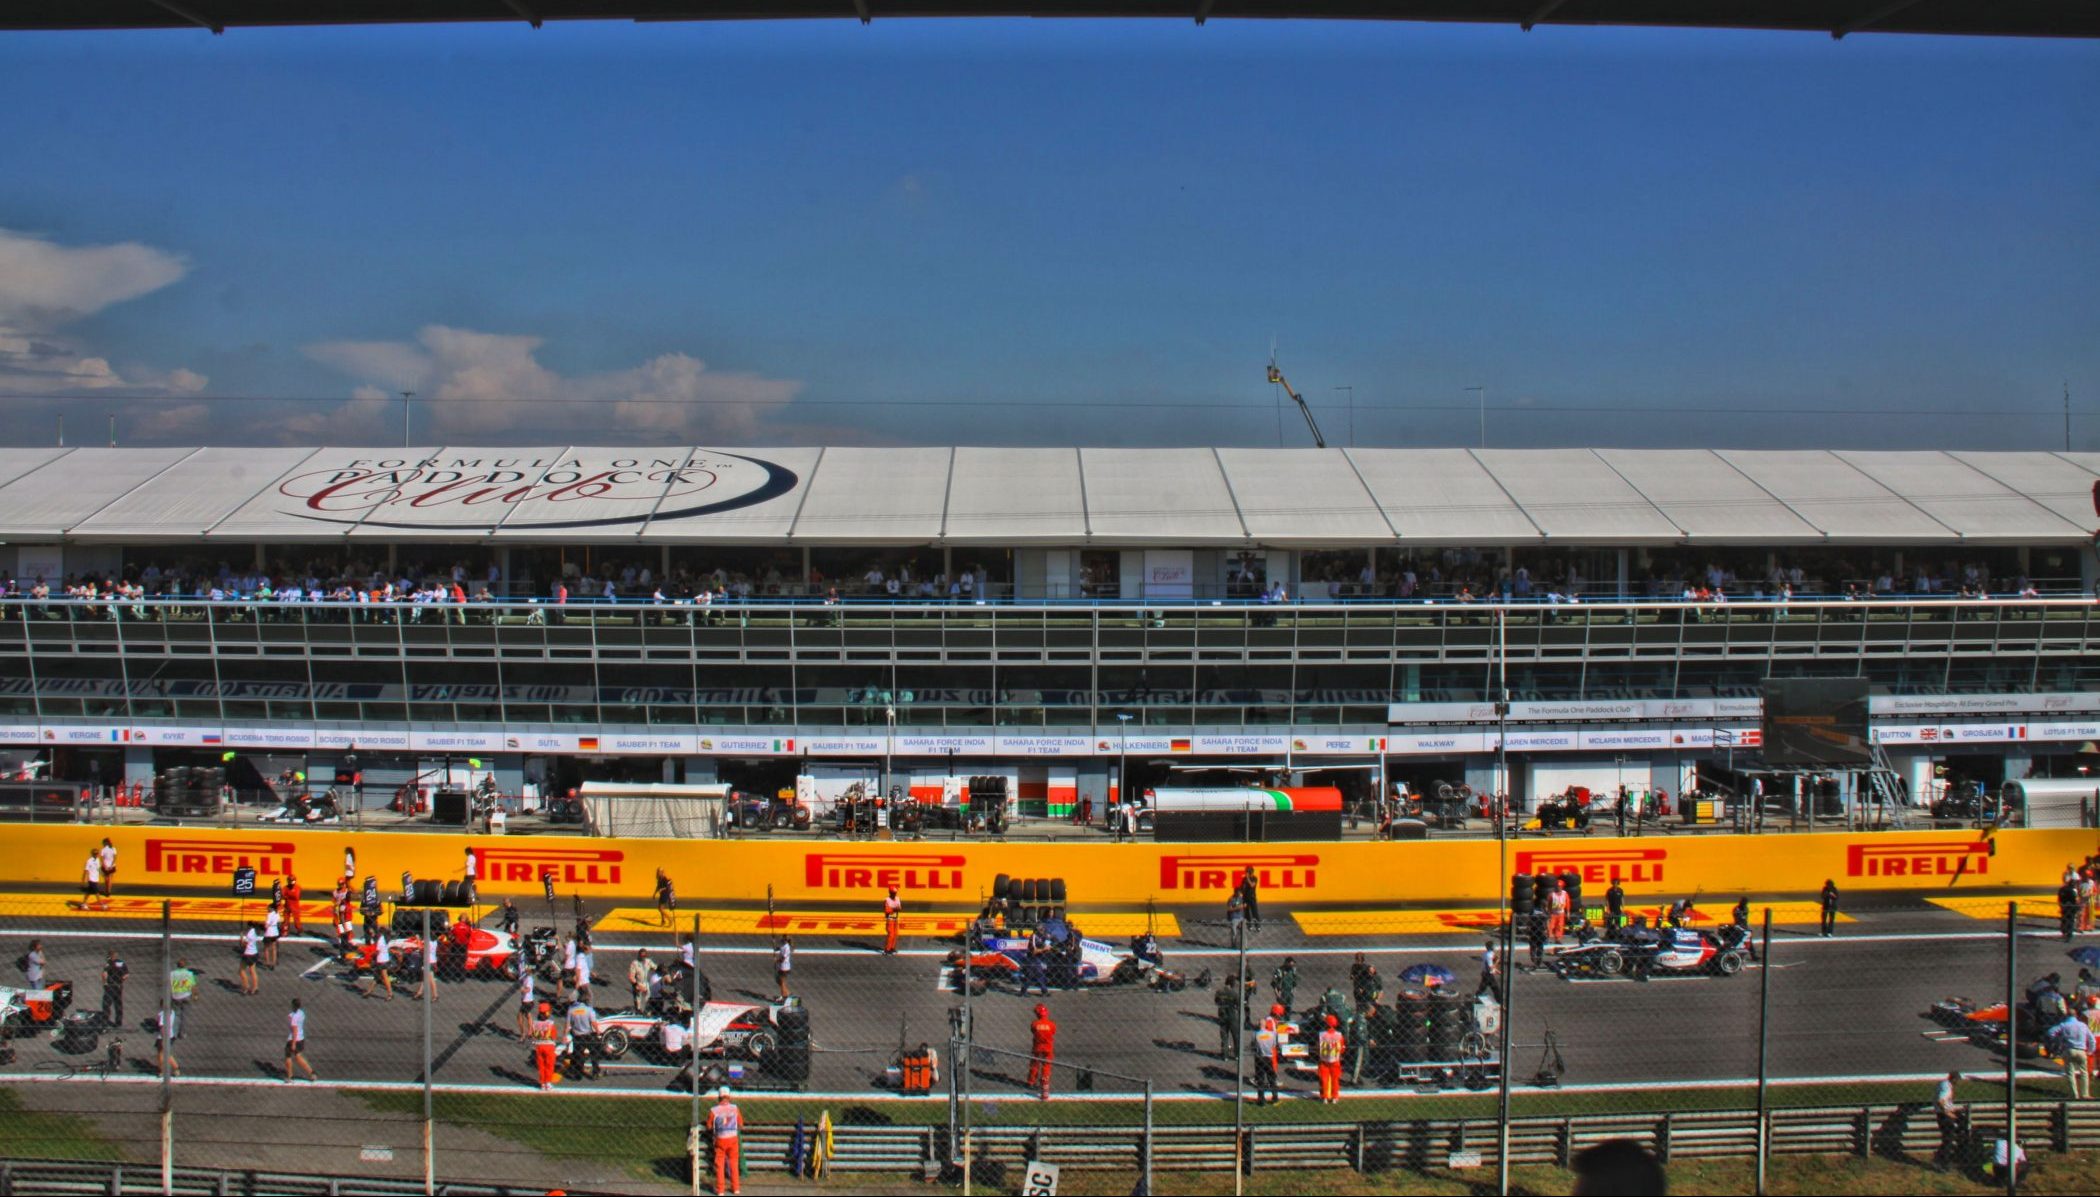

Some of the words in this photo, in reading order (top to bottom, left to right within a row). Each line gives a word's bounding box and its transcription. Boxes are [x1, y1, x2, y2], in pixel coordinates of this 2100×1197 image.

[347, 458, 583, 468] FORMULA
[611, 458, 707, 468] ONE
[327, 470, 696, 484] PADDOCK
[290, 468, 680, 511] Club
[1541, 706, 1569, 714] Formula
[1586, 705, 1614, 713] Paddock
[1615, 705, 1631, 713] Club
[10, 731, 36, 739] ROSSO
[69, 731, 102, 740] VERGNE
[1879, 731, 1911, 739] BUTTON
[1962, 729, 2004, 737] GROSJEAN
[2043, 728, 2066, 736] LOTUS
[2077, 727, 2097, 735] TEAM
[228, 734, 263, 742] SCUDERIA
[285, 735, 310, 743] ROSSO
[319, 736, 356, 744] SCUDERIA
[358, 736, 378, 745] TORO
[380, 737, 406, 745] ROSSO
[426, 738, 455, 746] SAUBER
[457, 738, 465, 746] F1
[466, 738, 486, 746] TEAM
[538, 739, 560, 747] SUTIL
[903, 738, 935, 746] SAHARA
[936, 738, 960, 747] FORCE
[963, 738, 986, 747] INDIA
[1003, 738, 1034, 746] SAHARA
[1036, 738, 1062, 747] FORCE
[1064, 738, 1085, 747] INDIA
[1494, 738, 1529, 746] MLAREN
[1530, 738, 1568, 746] MERCEDES
[1588, 736, 1622, 744] MCLAREN
[1623, 736, 1662, 744] MERCEDES
[616, 740, 648, 748] SAUBER
[720, 741, 768, 750] GUTIERREZ
[812, 742, 844, 750] SAUBER
[845, 742, 854, 750] F1
[856, 742, 878, 750] TEAM
[1326, 741, 1351, 749] PEREZ
[1417, 740, 1455, 748] WALKWAY
[145, 839, 296, 875] PIRELLI
[1847, 842, 1990, 877] PIRELLI
[472, 847, 624, 884] PIRELLI
[805, 854, 967, 889] PIRELLI
[236, 878, 253, 890] 25
[534, 943, 546, 955] 16
[1081, 940, 1111, 954] RIDENT
